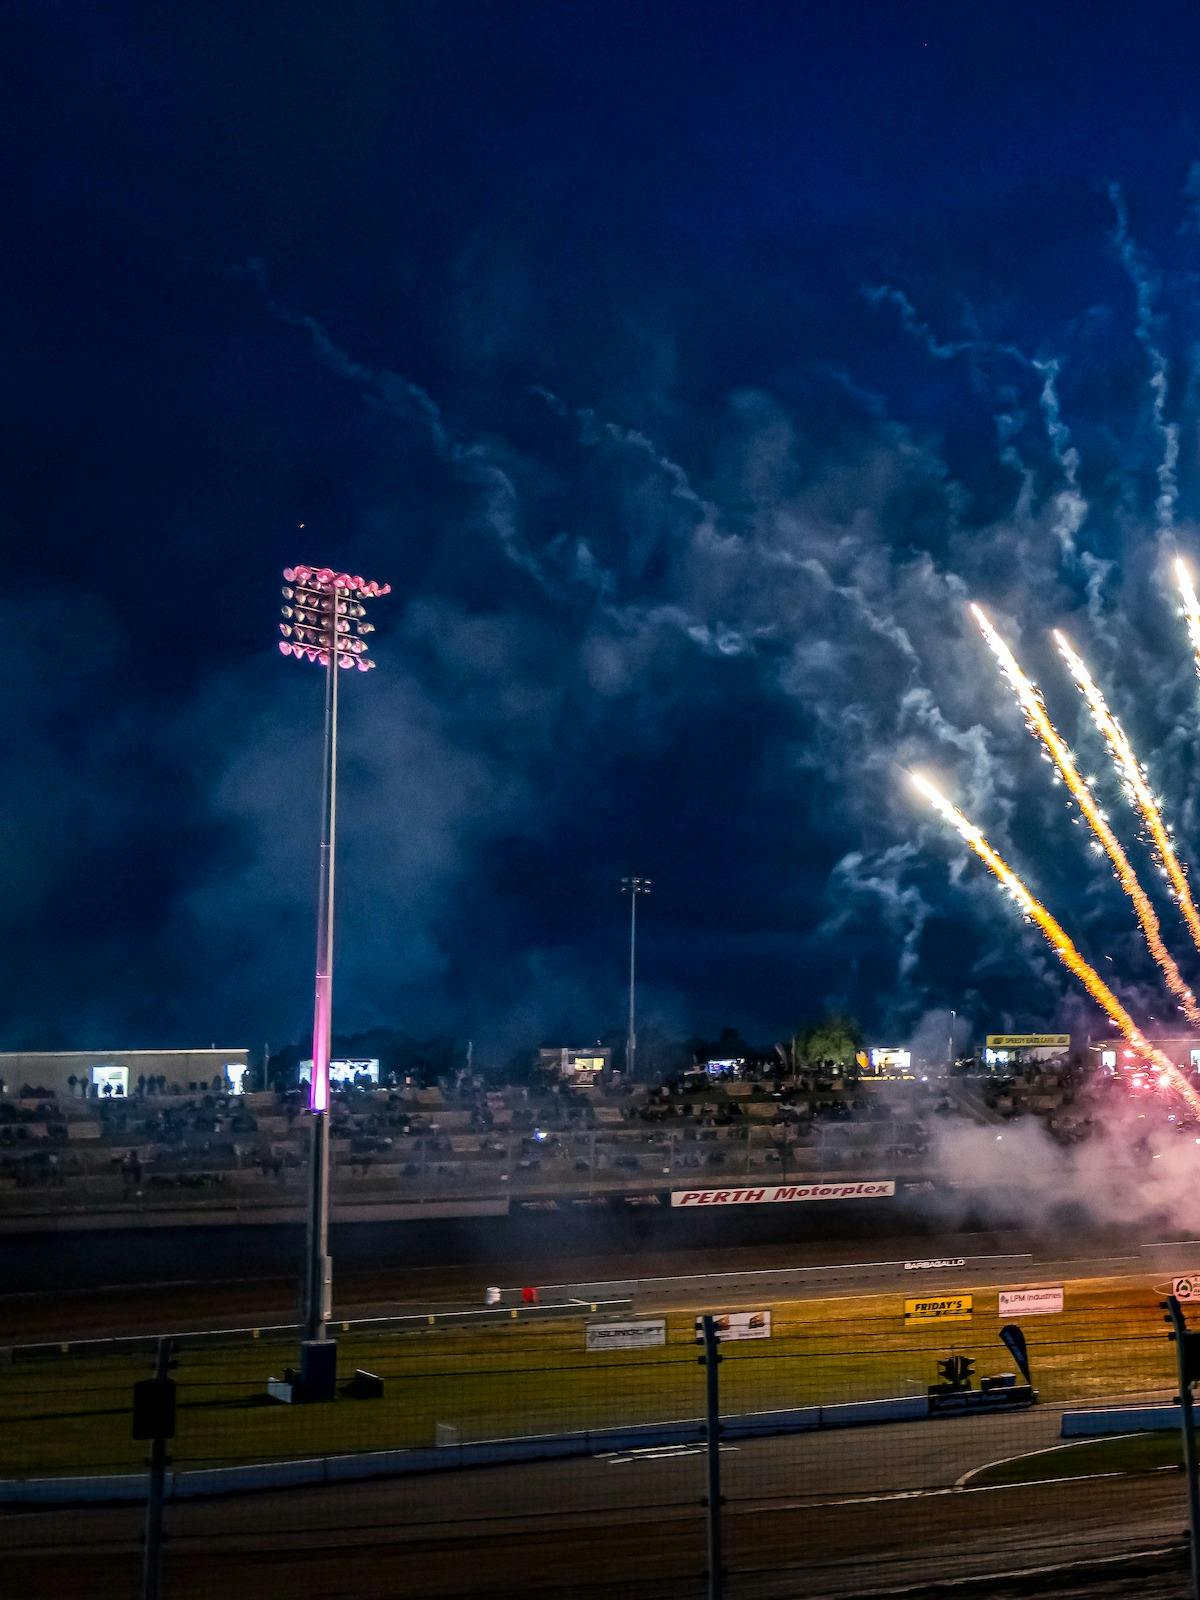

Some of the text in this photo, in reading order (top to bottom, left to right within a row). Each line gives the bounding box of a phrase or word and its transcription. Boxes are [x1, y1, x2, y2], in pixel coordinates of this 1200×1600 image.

[679, 1189, 767, 1205] PERTH
[773, 1184, 889, 1201] Motorplex
[914, 1300, 962, 1312] FRIDAY'S
